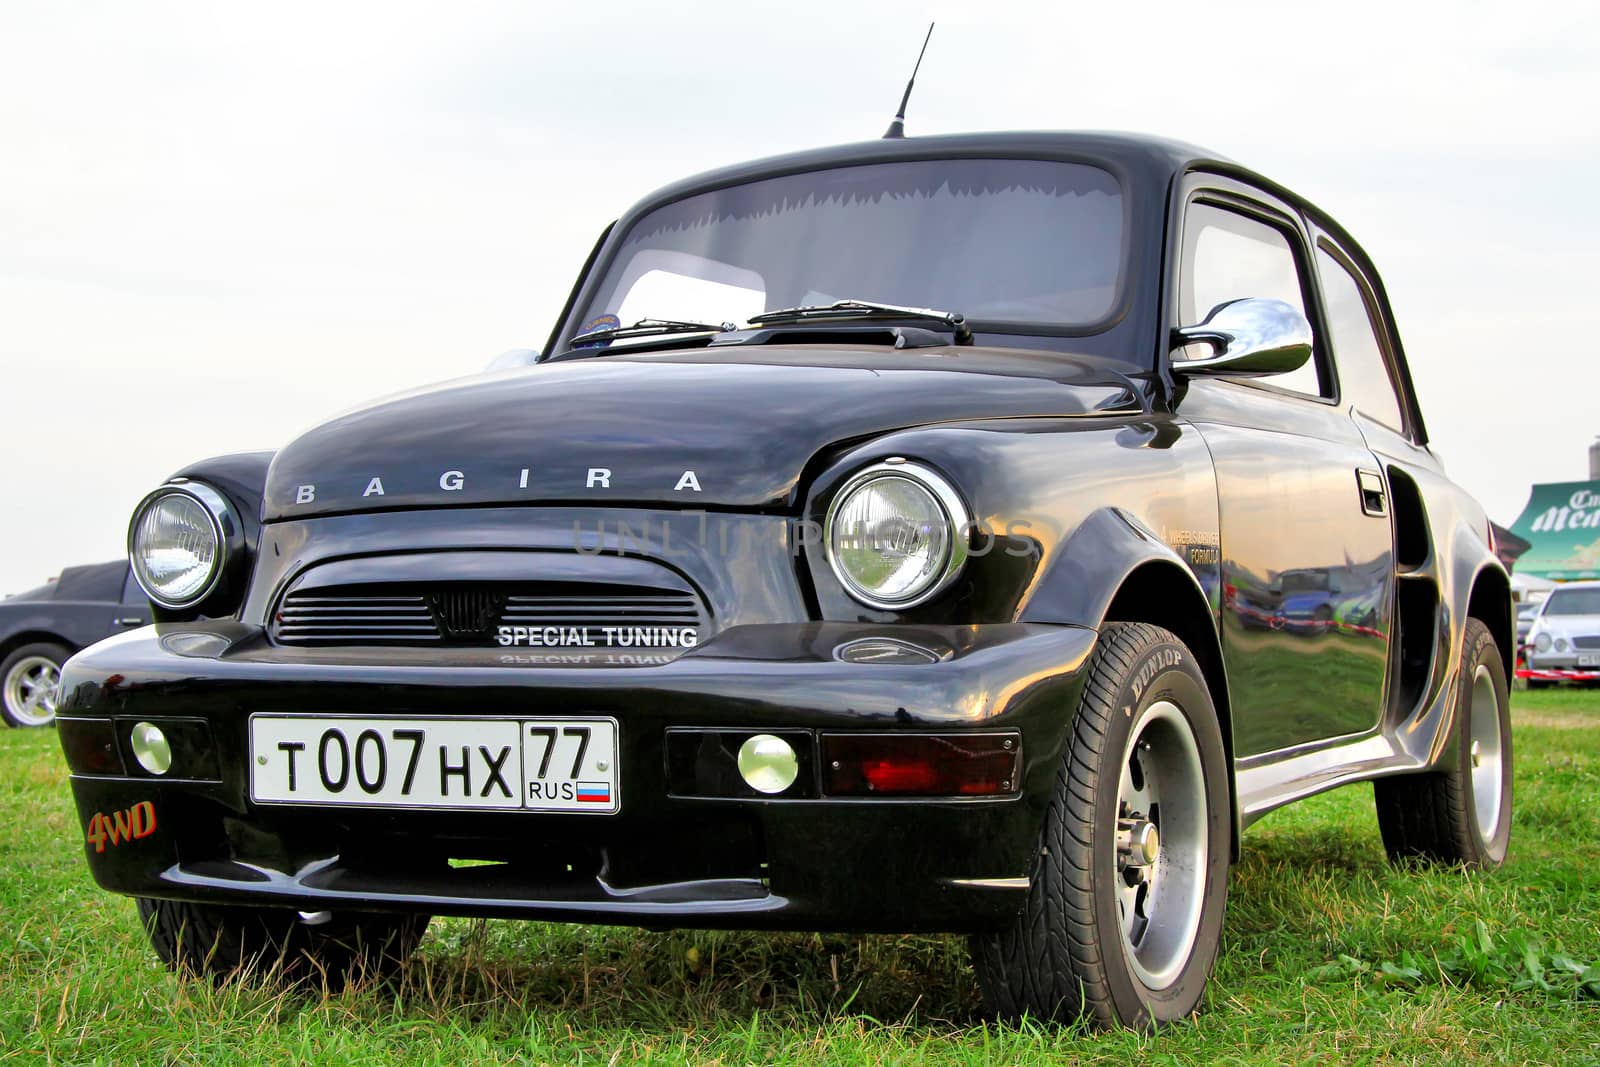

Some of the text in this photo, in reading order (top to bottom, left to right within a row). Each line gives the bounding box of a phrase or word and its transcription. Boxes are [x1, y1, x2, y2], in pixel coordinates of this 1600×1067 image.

[296, 468, 702, 504] BAGIRA
[498, 627, 697, 648] SPECIAL TUNING
[1131, 649, 1183, 703] DUNLOP
[530, 726, 592, 779] 77
[529, 781, 574, 801] RUS
[87, 801, 156, 853] 4WD
